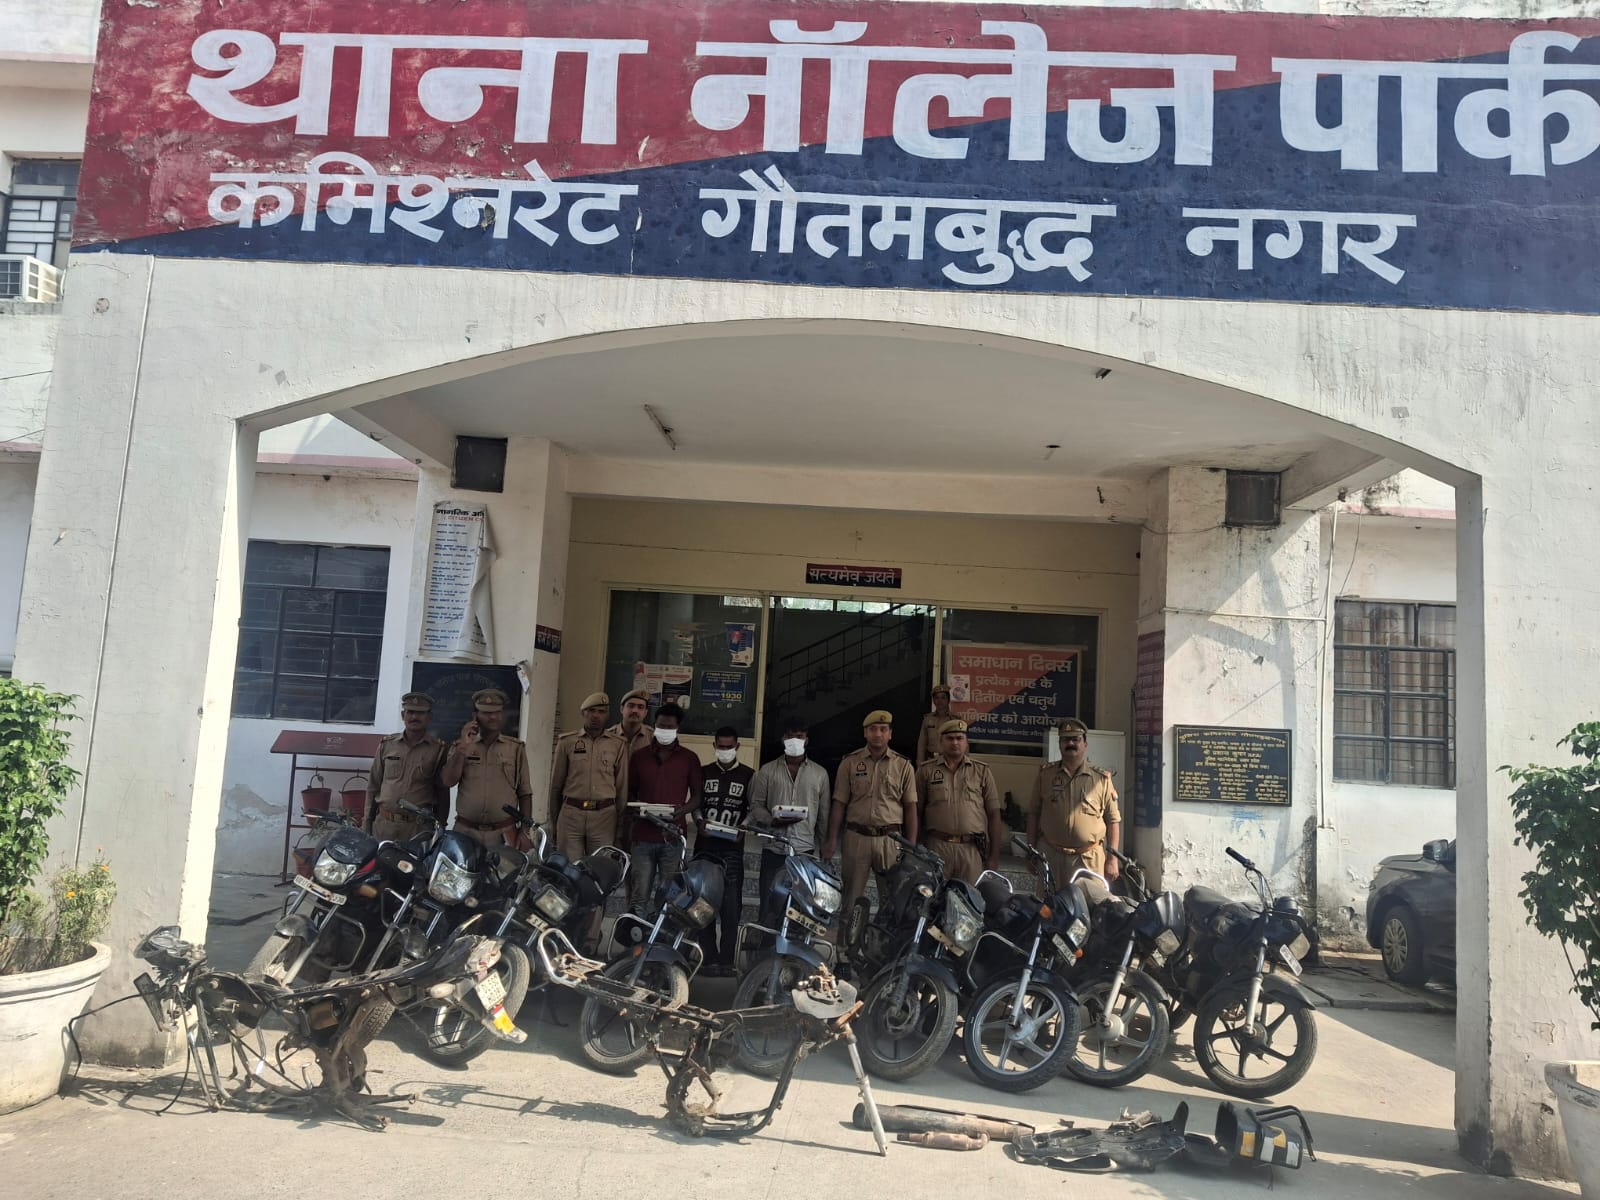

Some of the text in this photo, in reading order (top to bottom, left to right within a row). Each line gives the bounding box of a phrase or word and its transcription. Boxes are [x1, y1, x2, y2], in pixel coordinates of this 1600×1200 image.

[186, 19, 1600, 177] थाना नॉलेज पार्क
[206, 150, 1417, 286] कमिश्नरेट गौतमबुद्ध नगर
[809, 566, 895, 585] सत्यमेव जयते
[958, 653, 1073, 673] समाधान दिवस
[975, 673, 1054, 689] प्रत्येक माह के
[970, 689, 1058, 710] द्वितीय एवं चतुर्थ
[1001, 712, 1018, 724] को
[705, 780, 719, 791] AF
